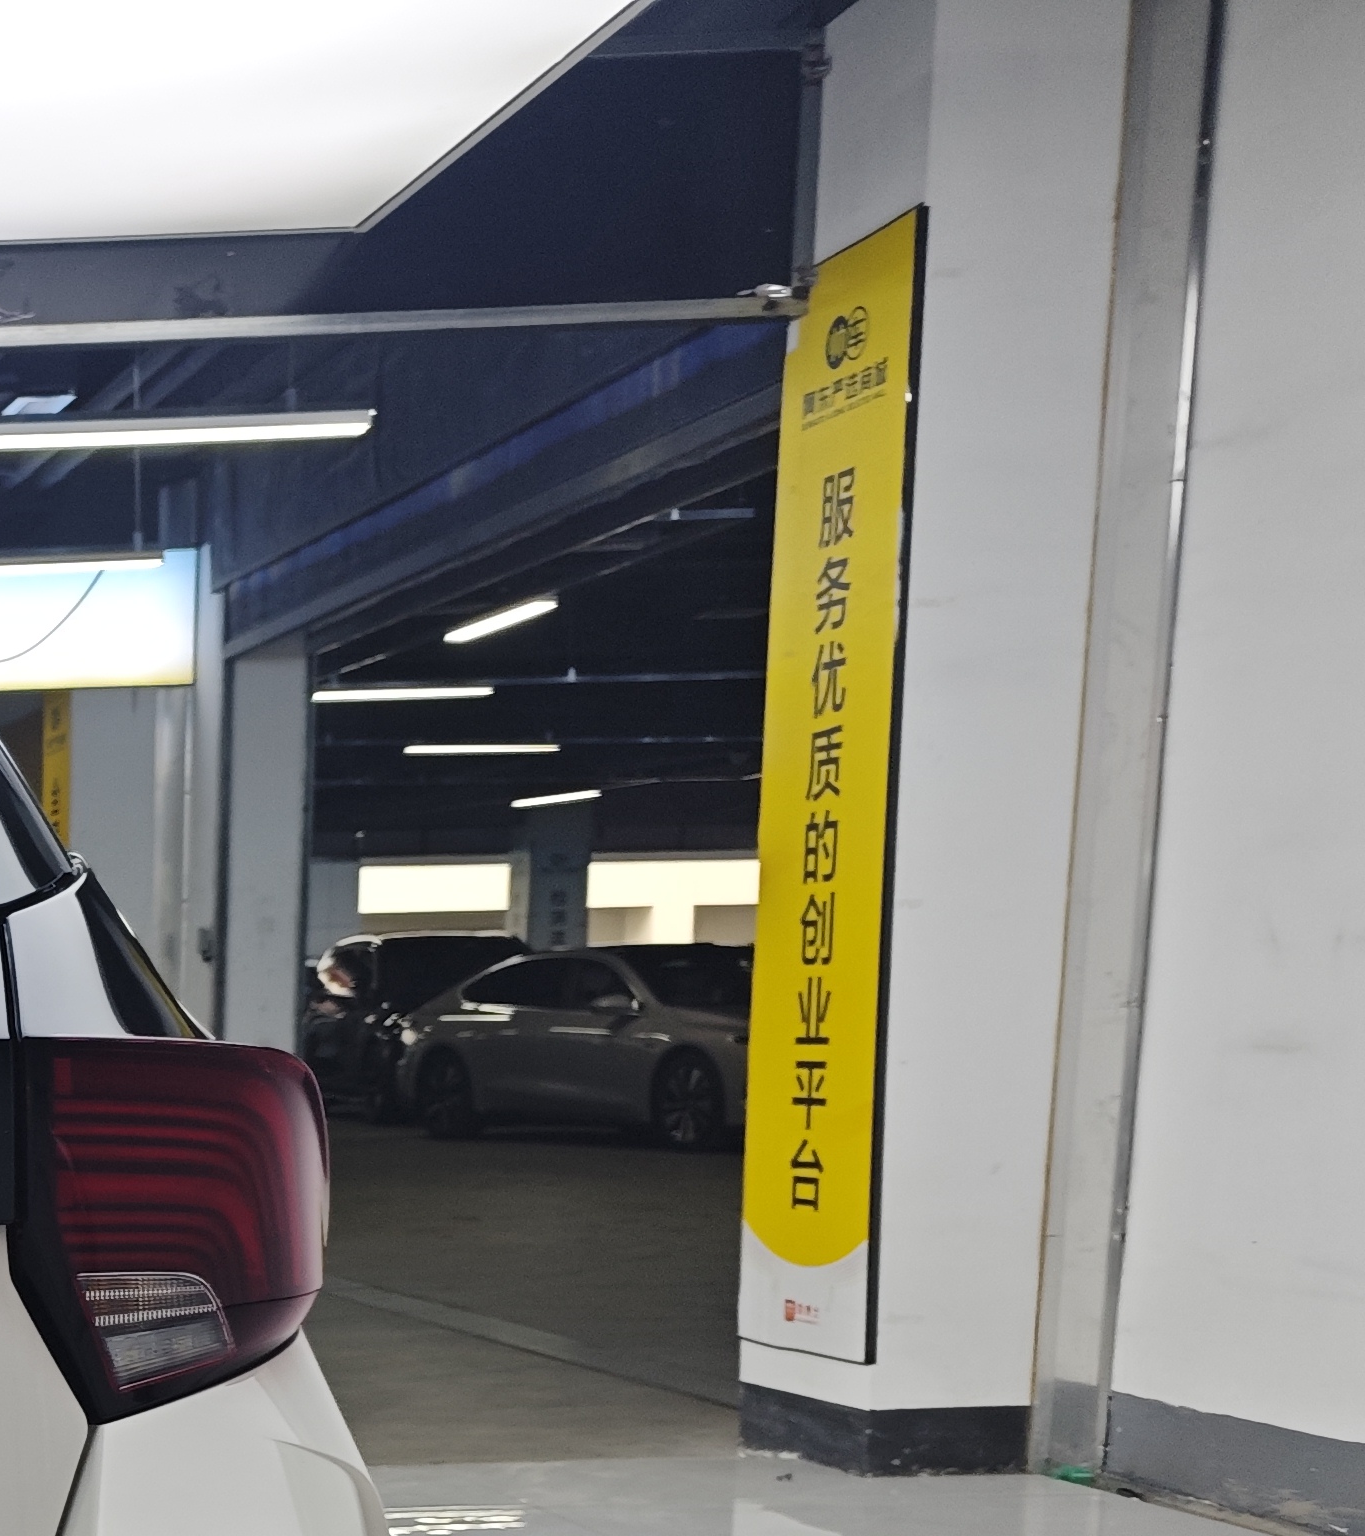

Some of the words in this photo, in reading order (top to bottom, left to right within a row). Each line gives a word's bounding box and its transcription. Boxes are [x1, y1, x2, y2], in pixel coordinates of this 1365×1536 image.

[789, 465, 857, 1212] 服务优质的创业平台
